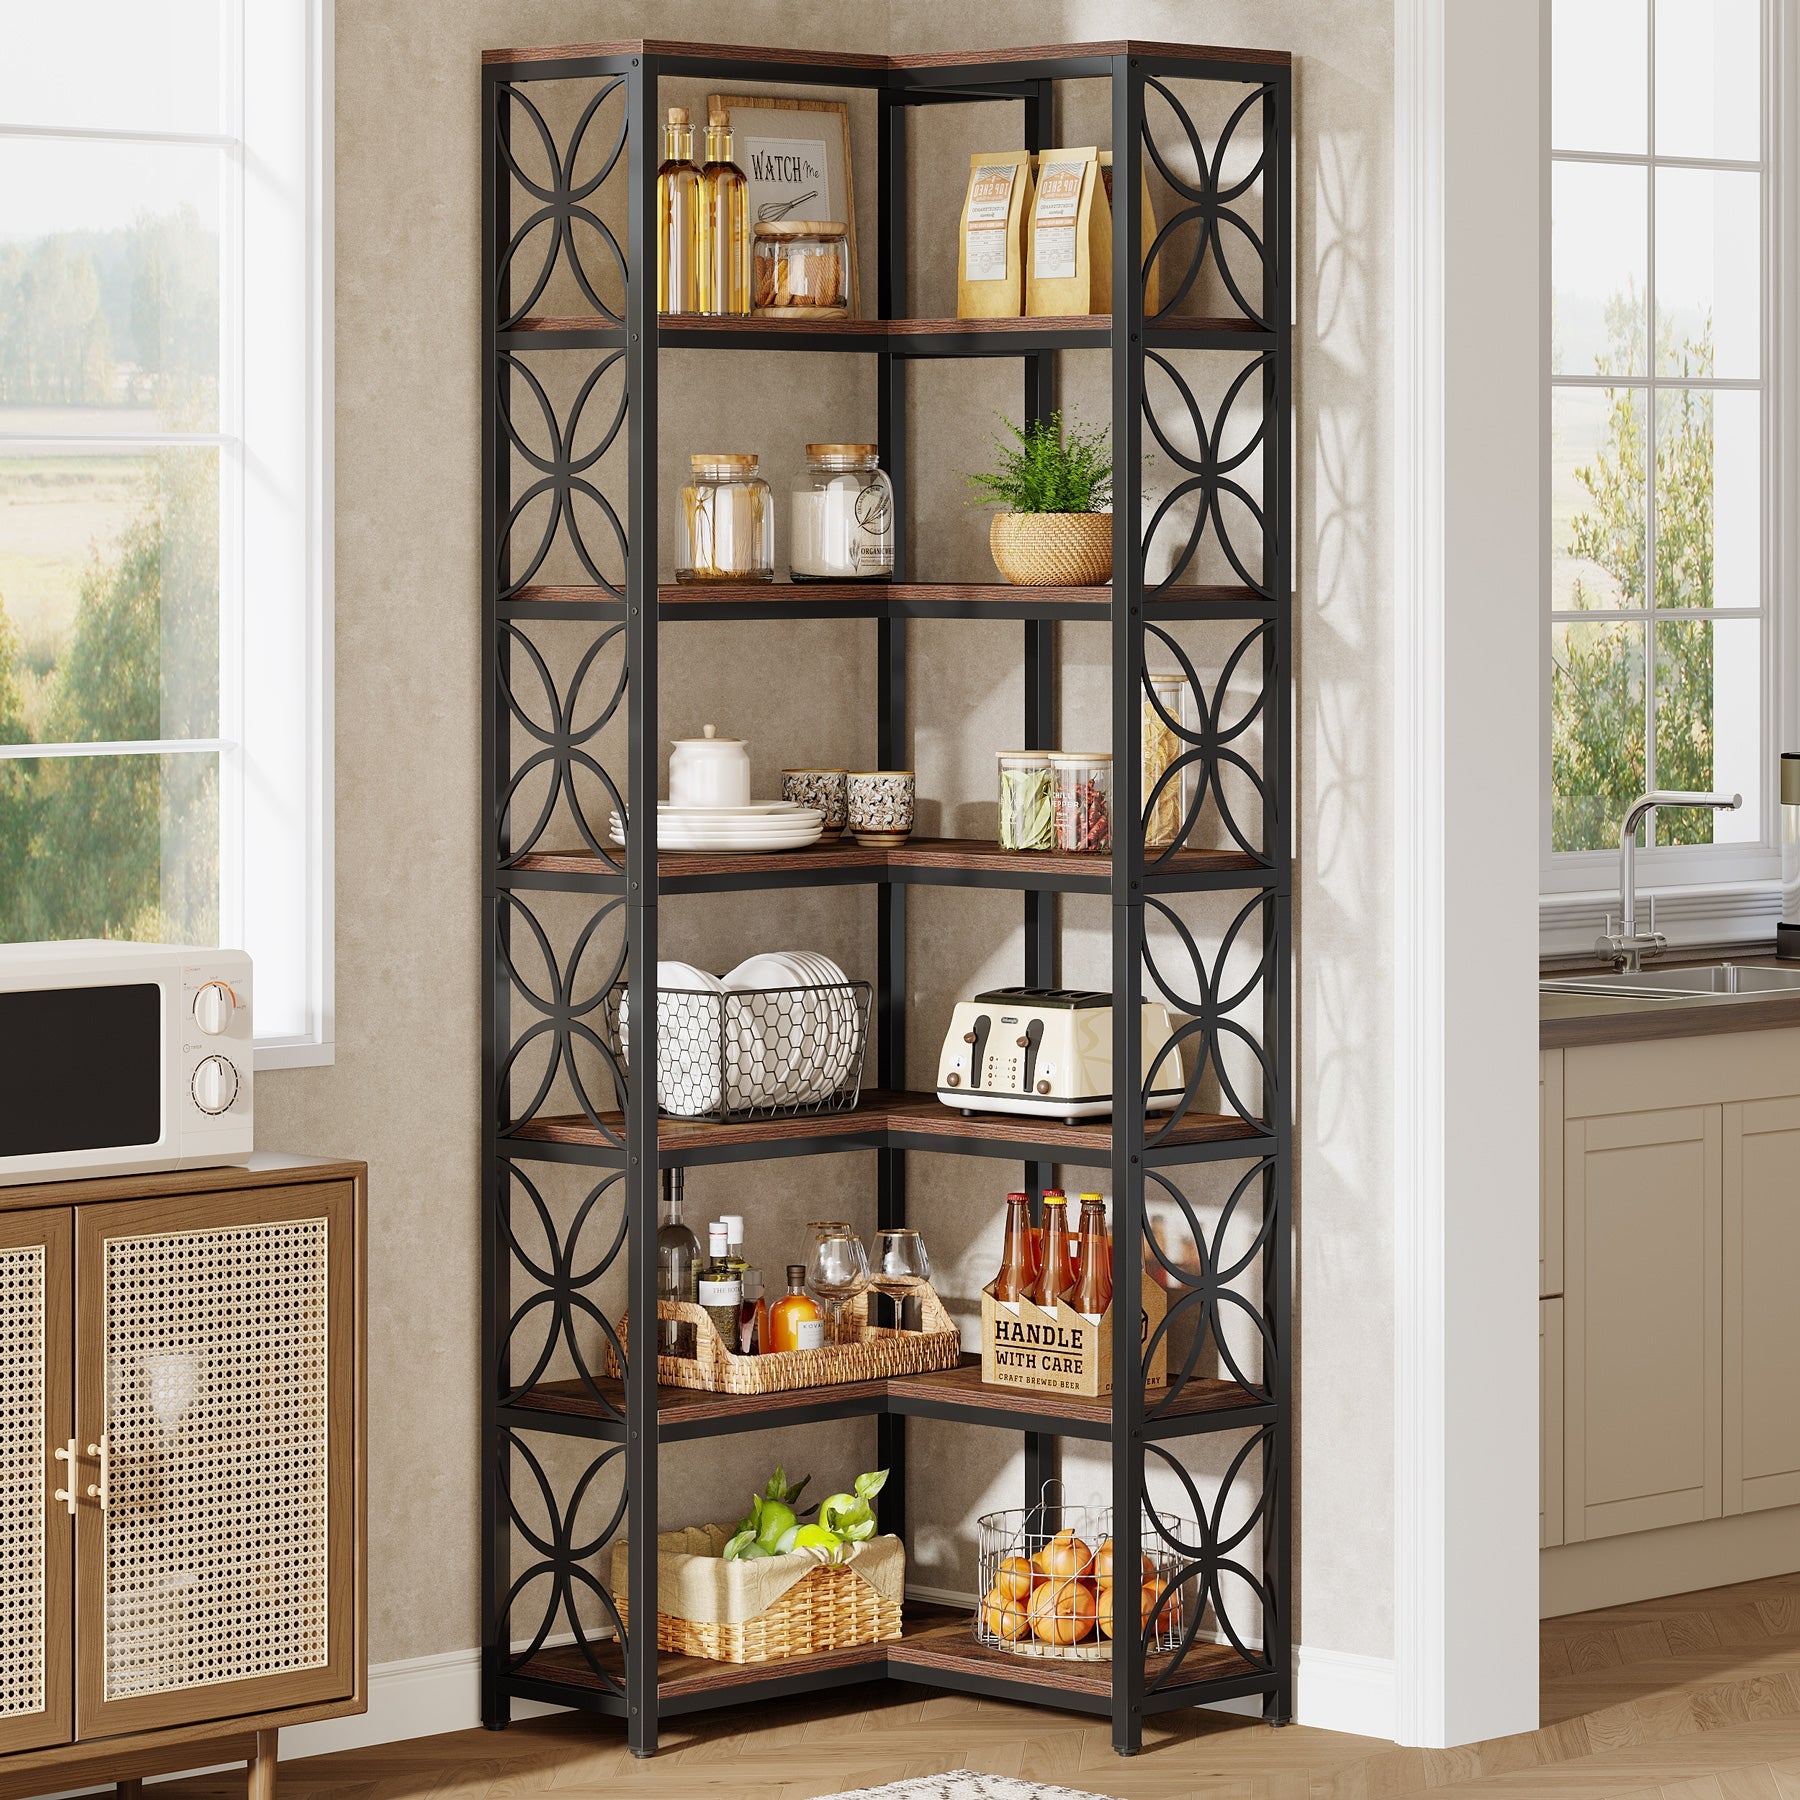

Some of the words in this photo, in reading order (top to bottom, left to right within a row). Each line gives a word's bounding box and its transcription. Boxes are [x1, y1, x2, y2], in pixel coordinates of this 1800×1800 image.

[751, 149, 802, 182] WATCH
[995, 1320, 1083, 1349] HANDLE
[996, 1350, 1036, 1369] WITH
[1042, 1355, 1083, 1375] CARE
[998, 1373, 1023, 1383] CRAFT
[1026, 1376, 1058, 1387] BREWED
[1060, 1380, 1080, 1390] BEER
